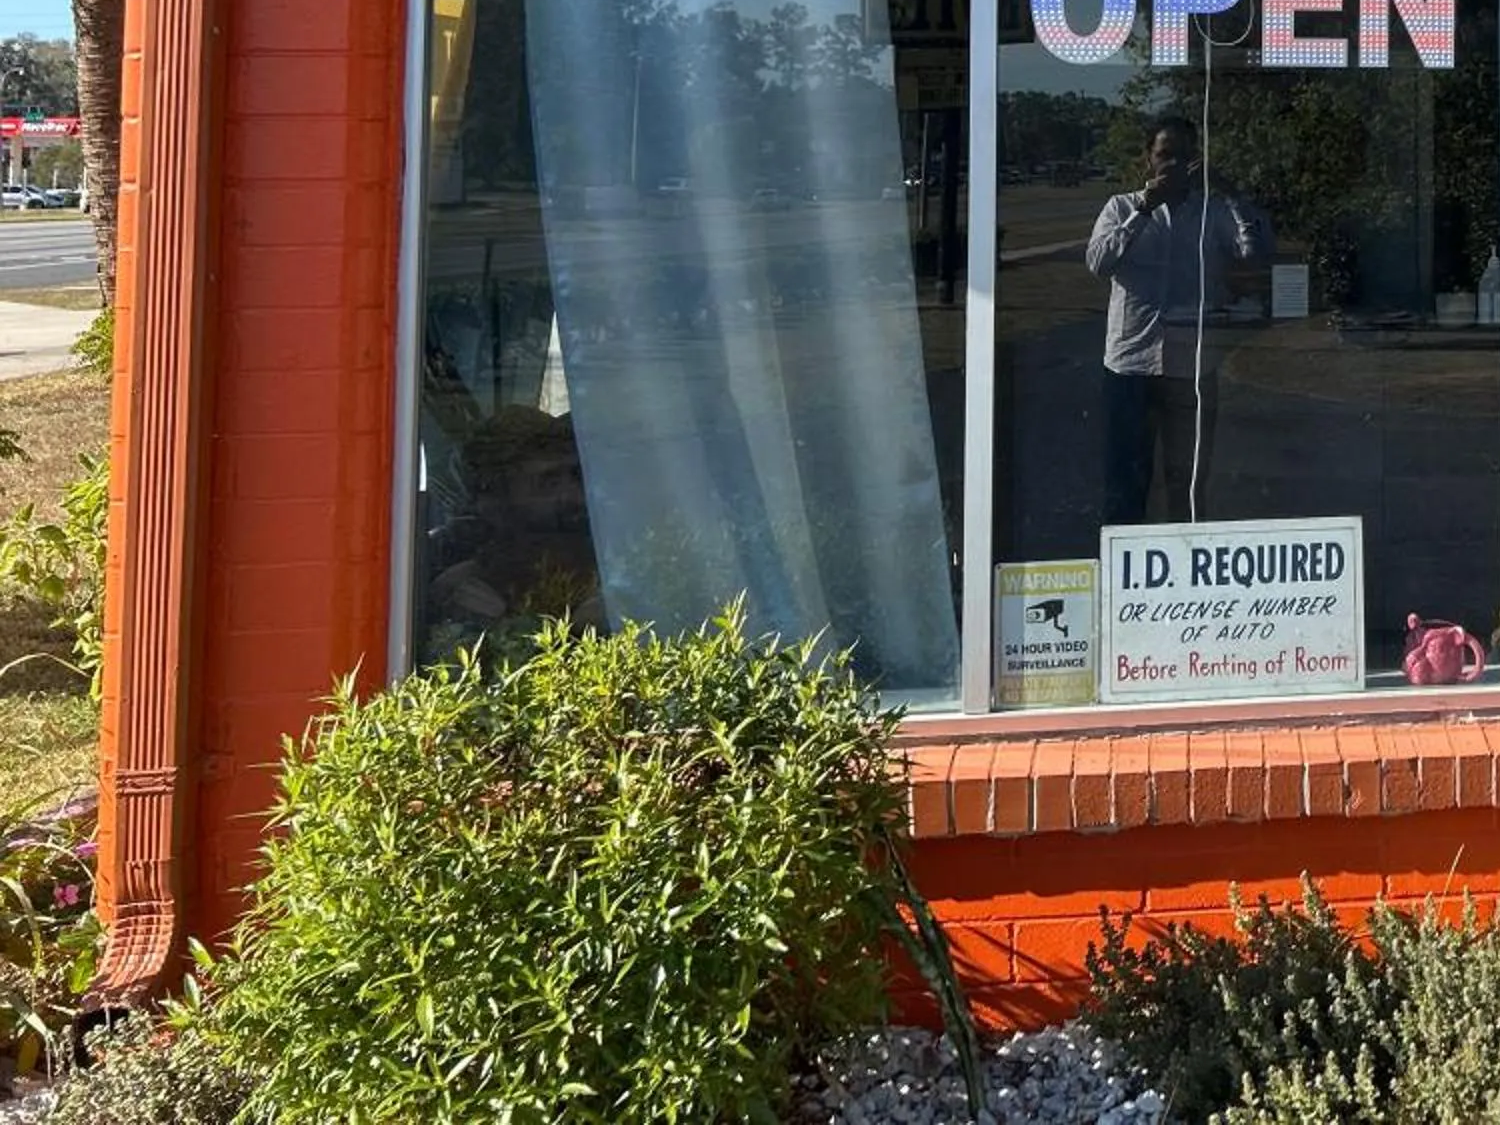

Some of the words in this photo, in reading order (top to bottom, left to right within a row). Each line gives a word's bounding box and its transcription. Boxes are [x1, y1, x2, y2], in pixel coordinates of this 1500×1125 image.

[1122, 549, 1174, 590] I.D.
[1191, 542, 1345, 587] REQUIRED
[1004, 571, 1090, 593] WARNING
[1119, 602, 1147, 622] OR
[1150, 599, 1240, 620] LICENSE
[1247, 595, 1338, 617] NUMBER
[1181, 624, 1204, 643] OF
[1215, 622, 1275, 641] AUTO
[1005, 644, 1019, 656] 24
[1021, 642, 1053, 655] HOUR
[1054, 640, 1089, 654] VIDEO
[1007, 658, 1087, 671] SURVEILLANCE
[1117, 654, 1178, 682] Before
[1189, 649, 1258, 681] Renting
[1264, 648, 1285, 673] of
[1295, 646, 1349, 672] Room
